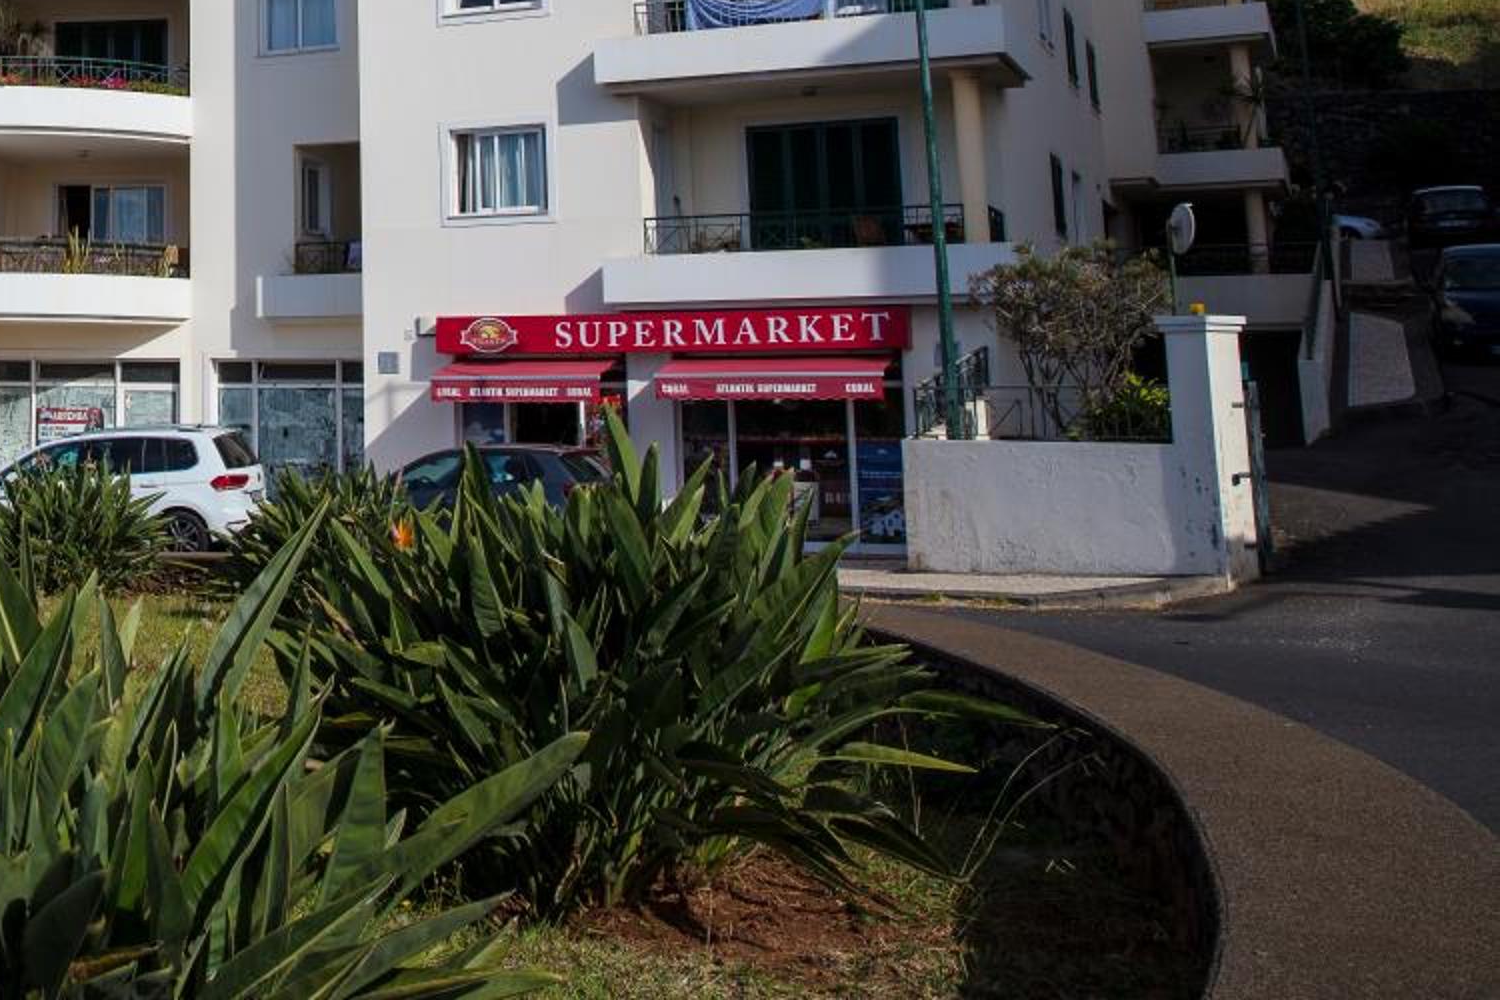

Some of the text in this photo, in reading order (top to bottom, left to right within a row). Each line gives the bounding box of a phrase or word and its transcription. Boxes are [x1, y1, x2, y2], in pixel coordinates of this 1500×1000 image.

[554, 311, 890, 348] SUPERMARKET
[757, 383, 817, 393] SUPERMARKET
[845, 383, 875, 393] CORAL
